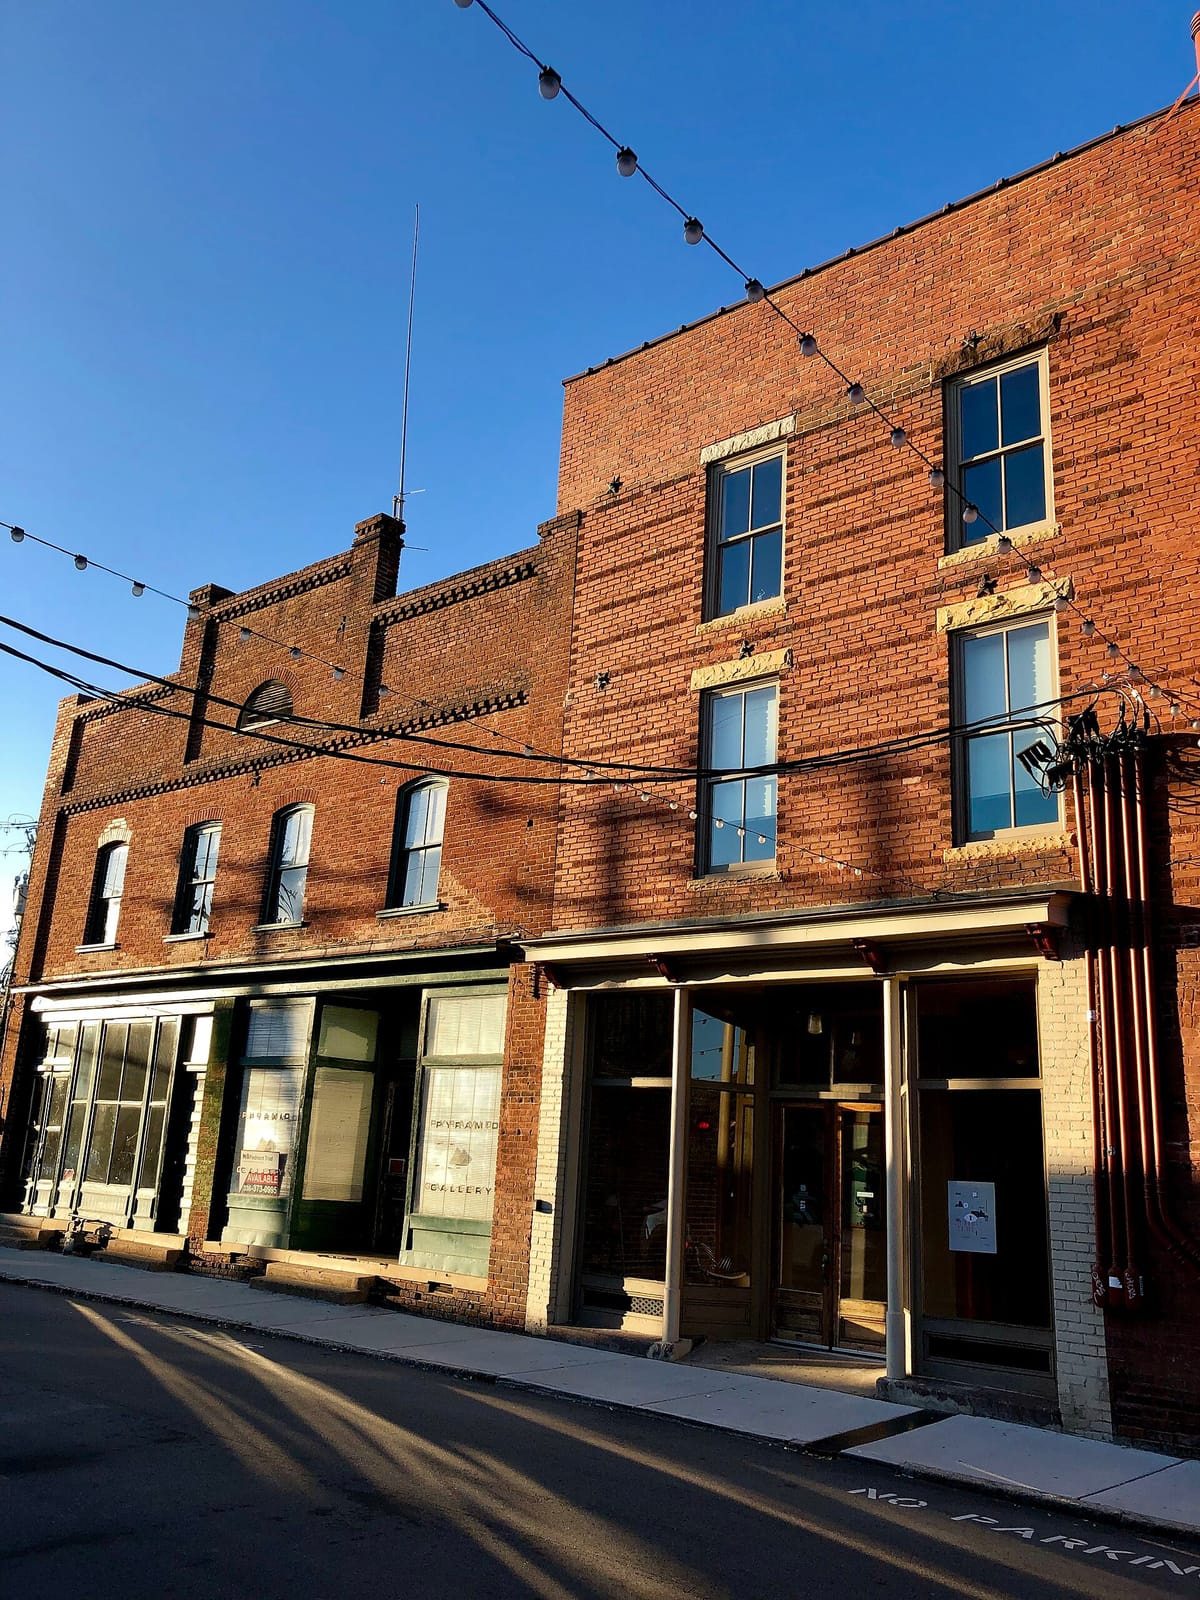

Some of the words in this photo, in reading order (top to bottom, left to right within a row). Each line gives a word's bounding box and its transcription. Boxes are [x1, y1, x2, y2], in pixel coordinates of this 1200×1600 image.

[435, 1121, 499, 1131] PYRAMID
[247, 1173, 278, 1184] AVAILABLE
[430, 1183, 492, 1195] GALLERY
[847, 1487, 929, 1509] NO
[951, 1513, 1200, 1579] PARKIN
